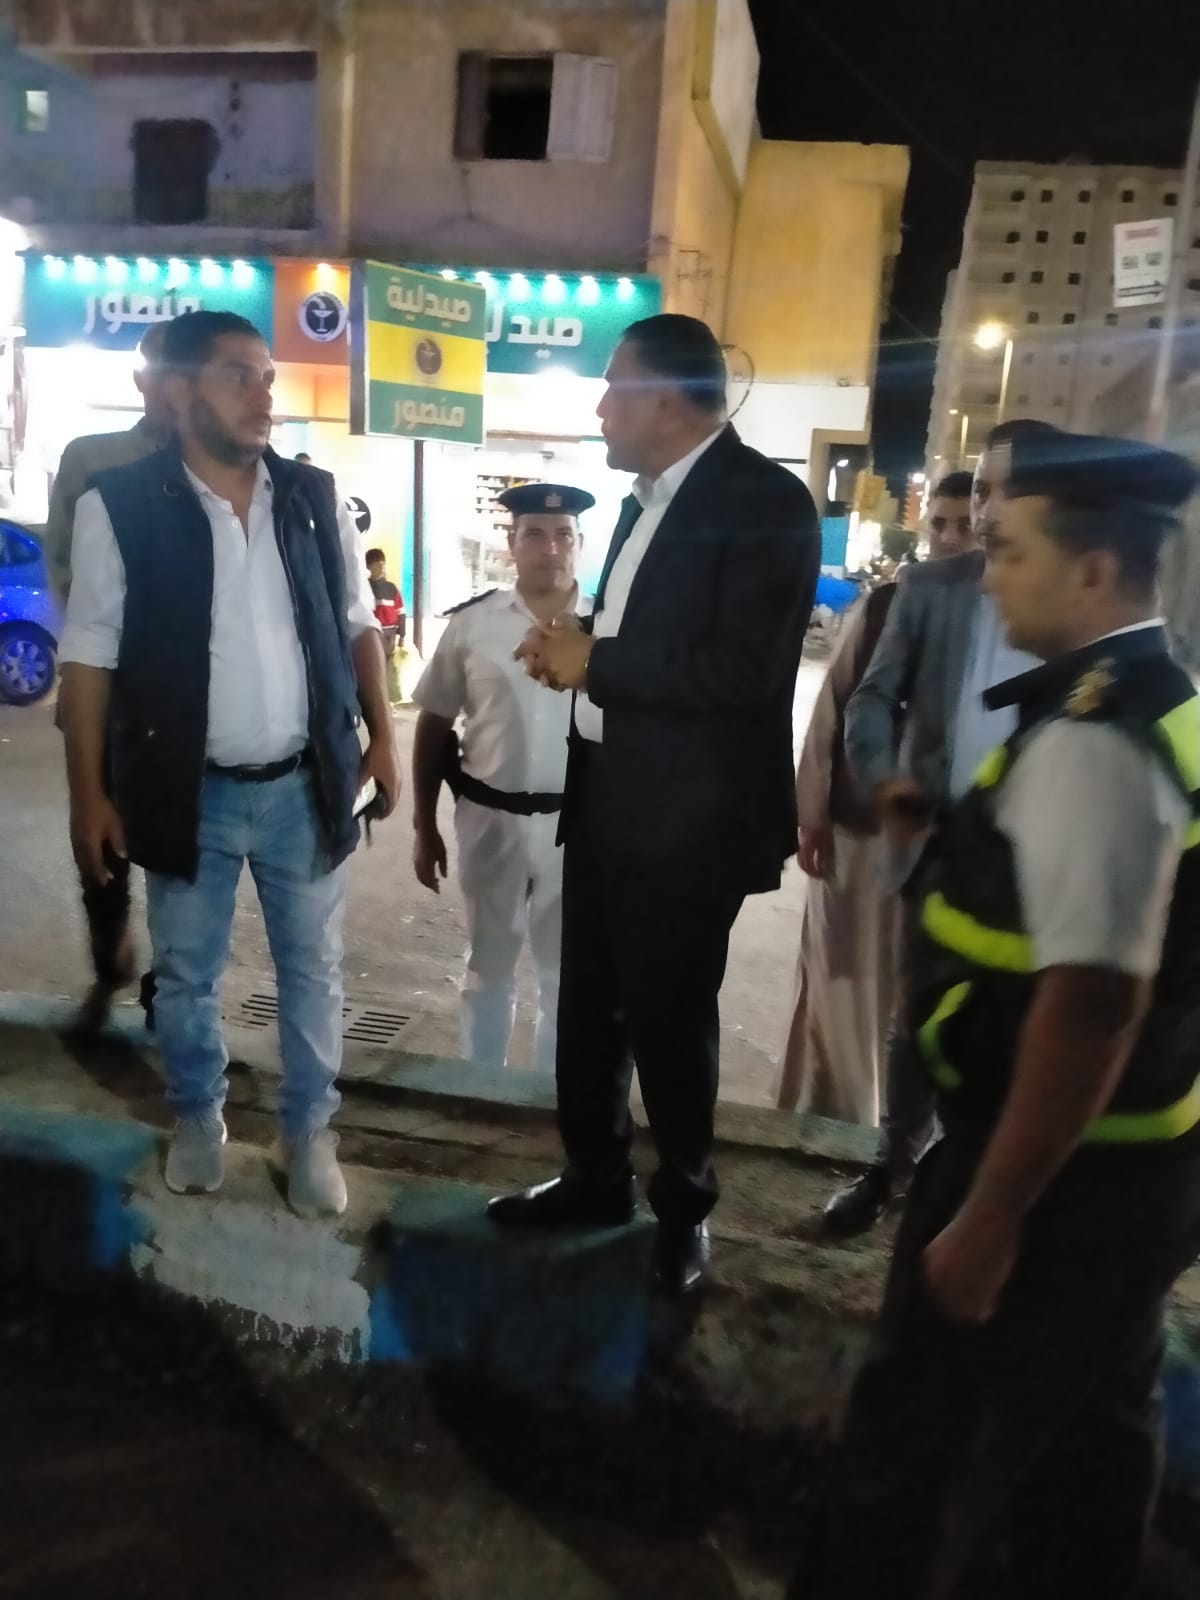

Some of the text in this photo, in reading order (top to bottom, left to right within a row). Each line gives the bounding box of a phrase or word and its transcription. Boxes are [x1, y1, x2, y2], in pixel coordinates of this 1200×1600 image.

[387, 276, 471, 327] صيدلية
[485, 300, 583, 359] صيدل
[393, 397, 465, 431] منصور
